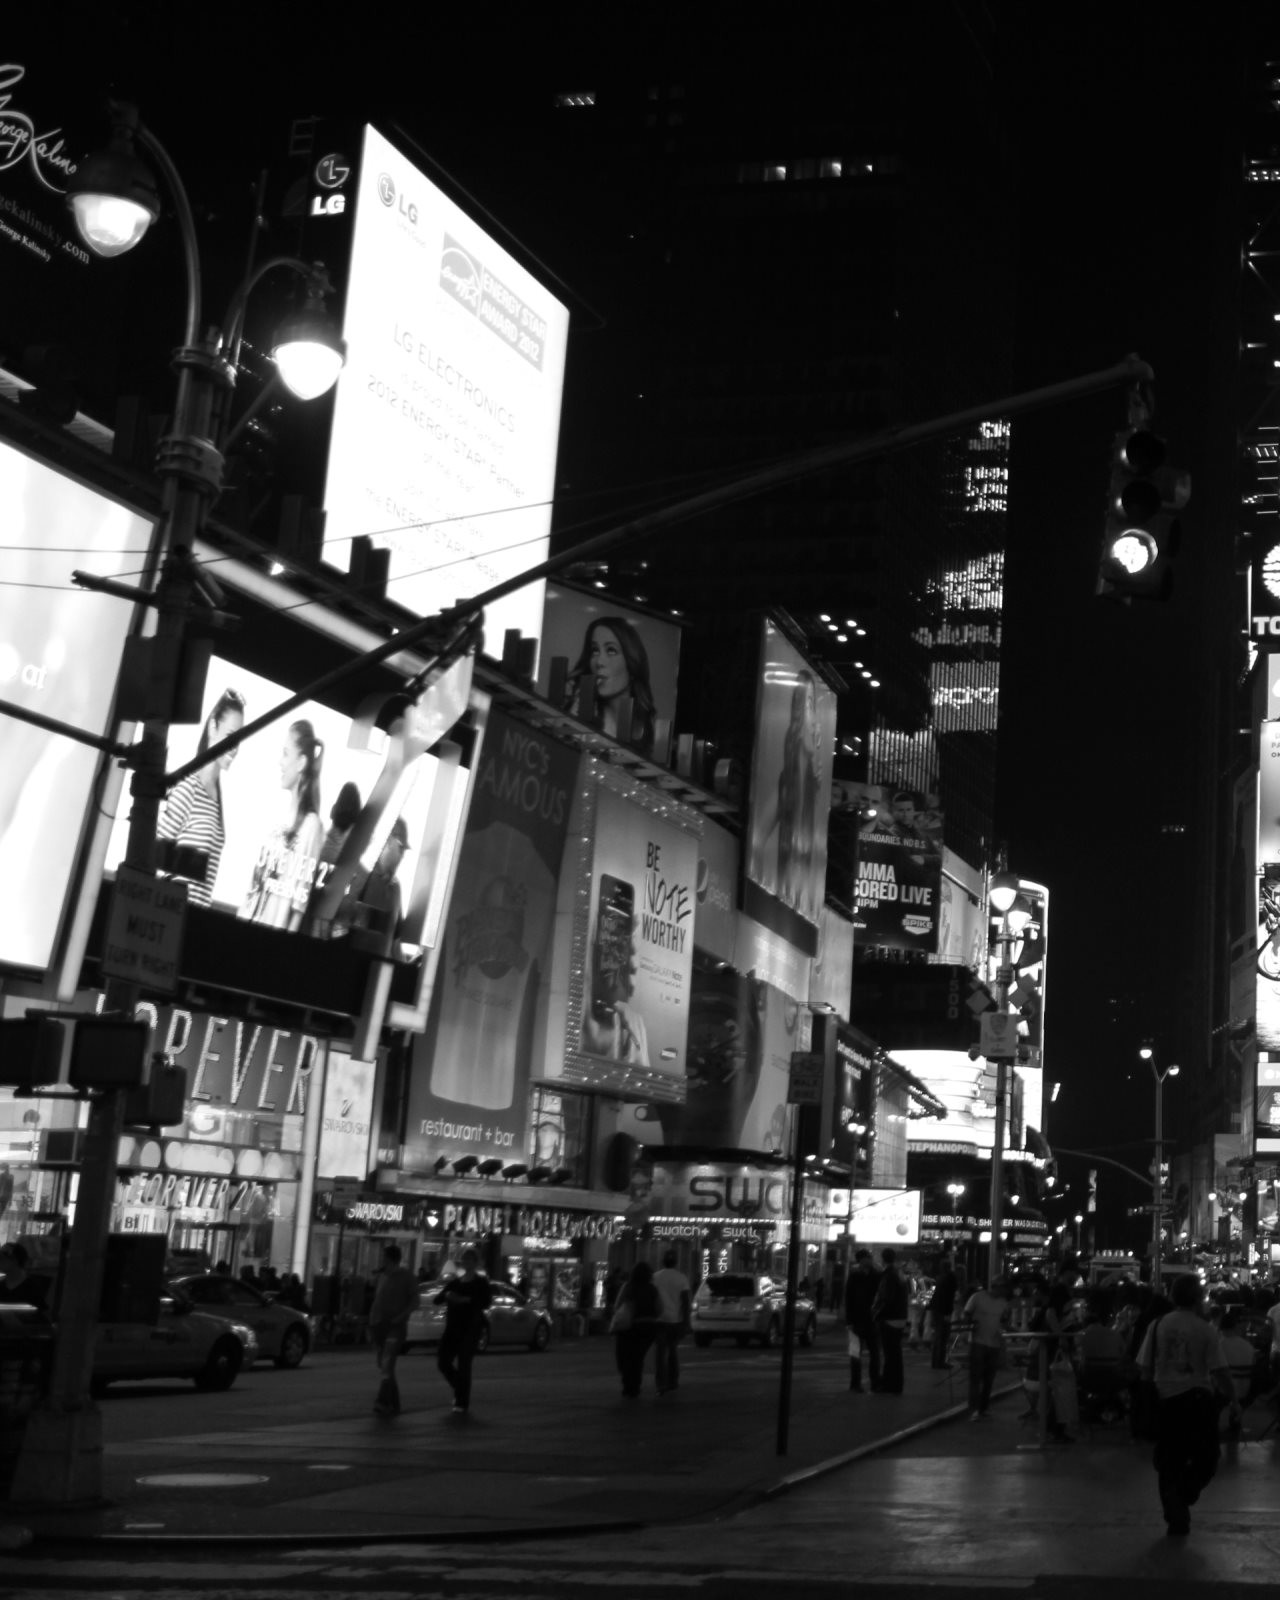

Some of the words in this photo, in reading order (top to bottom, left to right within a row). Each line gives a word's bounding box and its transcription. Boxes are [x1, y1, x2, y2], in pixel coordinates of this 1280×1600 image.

[314, 195, 345, 214] LG
[398, 193, 418, 226] LG
[481, 300, 518, 342] AWARD
[483, 273, 521, 318] ENERGY
[521, 308, 546, 342] STAR
[393, 320, 414, 354] LG
[418, 343, 515, 433] ELECTRONICS
[368, 374, 399, 408] 2012
[402, 399, 450, 441] ENERGY
[478, 756, 567, 826] AMOUS
[646, 841, 662, 872] BE
[903, 837, 914, 848] NO
[858, 861, 896, 883] MMA
[643, 871, 693, 924] NOTE
[901, 884, 933, 906] LIVE
[126, 913, 166, 945] MUST
[641, 912, 687, 954] WORTHY
[902, 918, 934, 929] SPIKE
[97, 994, 318, 1115] REVER
[323, 1118, 371, 1137] SWAROVSKI
[420, 1118, 483, 1143] restaurant
[494, 1126, 516, 1147] bar
[346, 1202, 403, 1222] SWAROVSKI
[443, 1204, 510, 1233] PLANET
[653, 1225, 701, 1237] swatch
